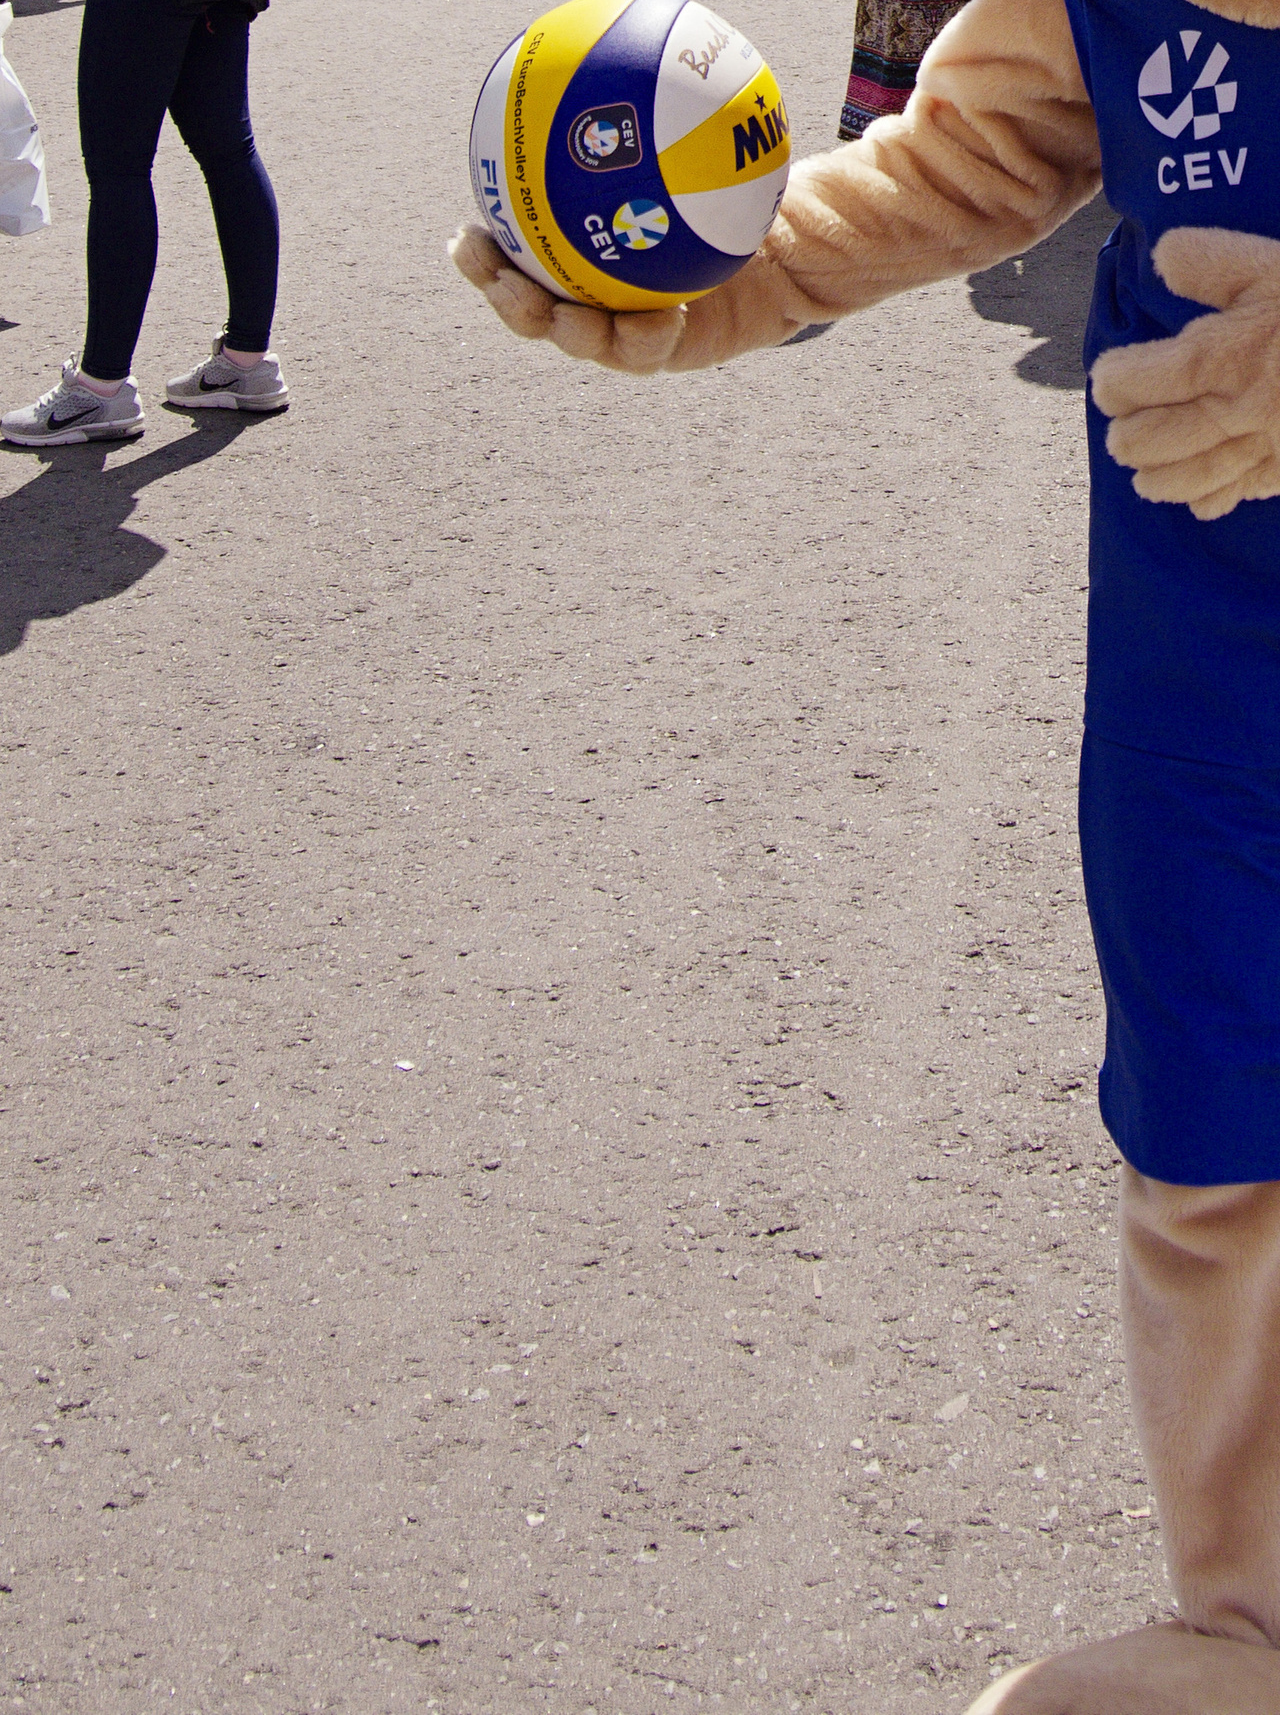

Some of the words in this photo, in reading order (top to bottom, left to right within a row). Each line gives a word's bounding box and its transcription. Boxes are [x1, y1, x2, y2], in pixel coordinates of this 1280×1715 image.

[527, 32, 544, 55] CEV
[513, 58, 534, 183] EuroBeachVolley
[621, 119, 635, 147] CEV
[1156, 147, 1249, 195] CEV
[520, 187, 538, 222] 2019
[536, 235, 574, 284] Moscow
[583, 214, 621, 261] CEV
